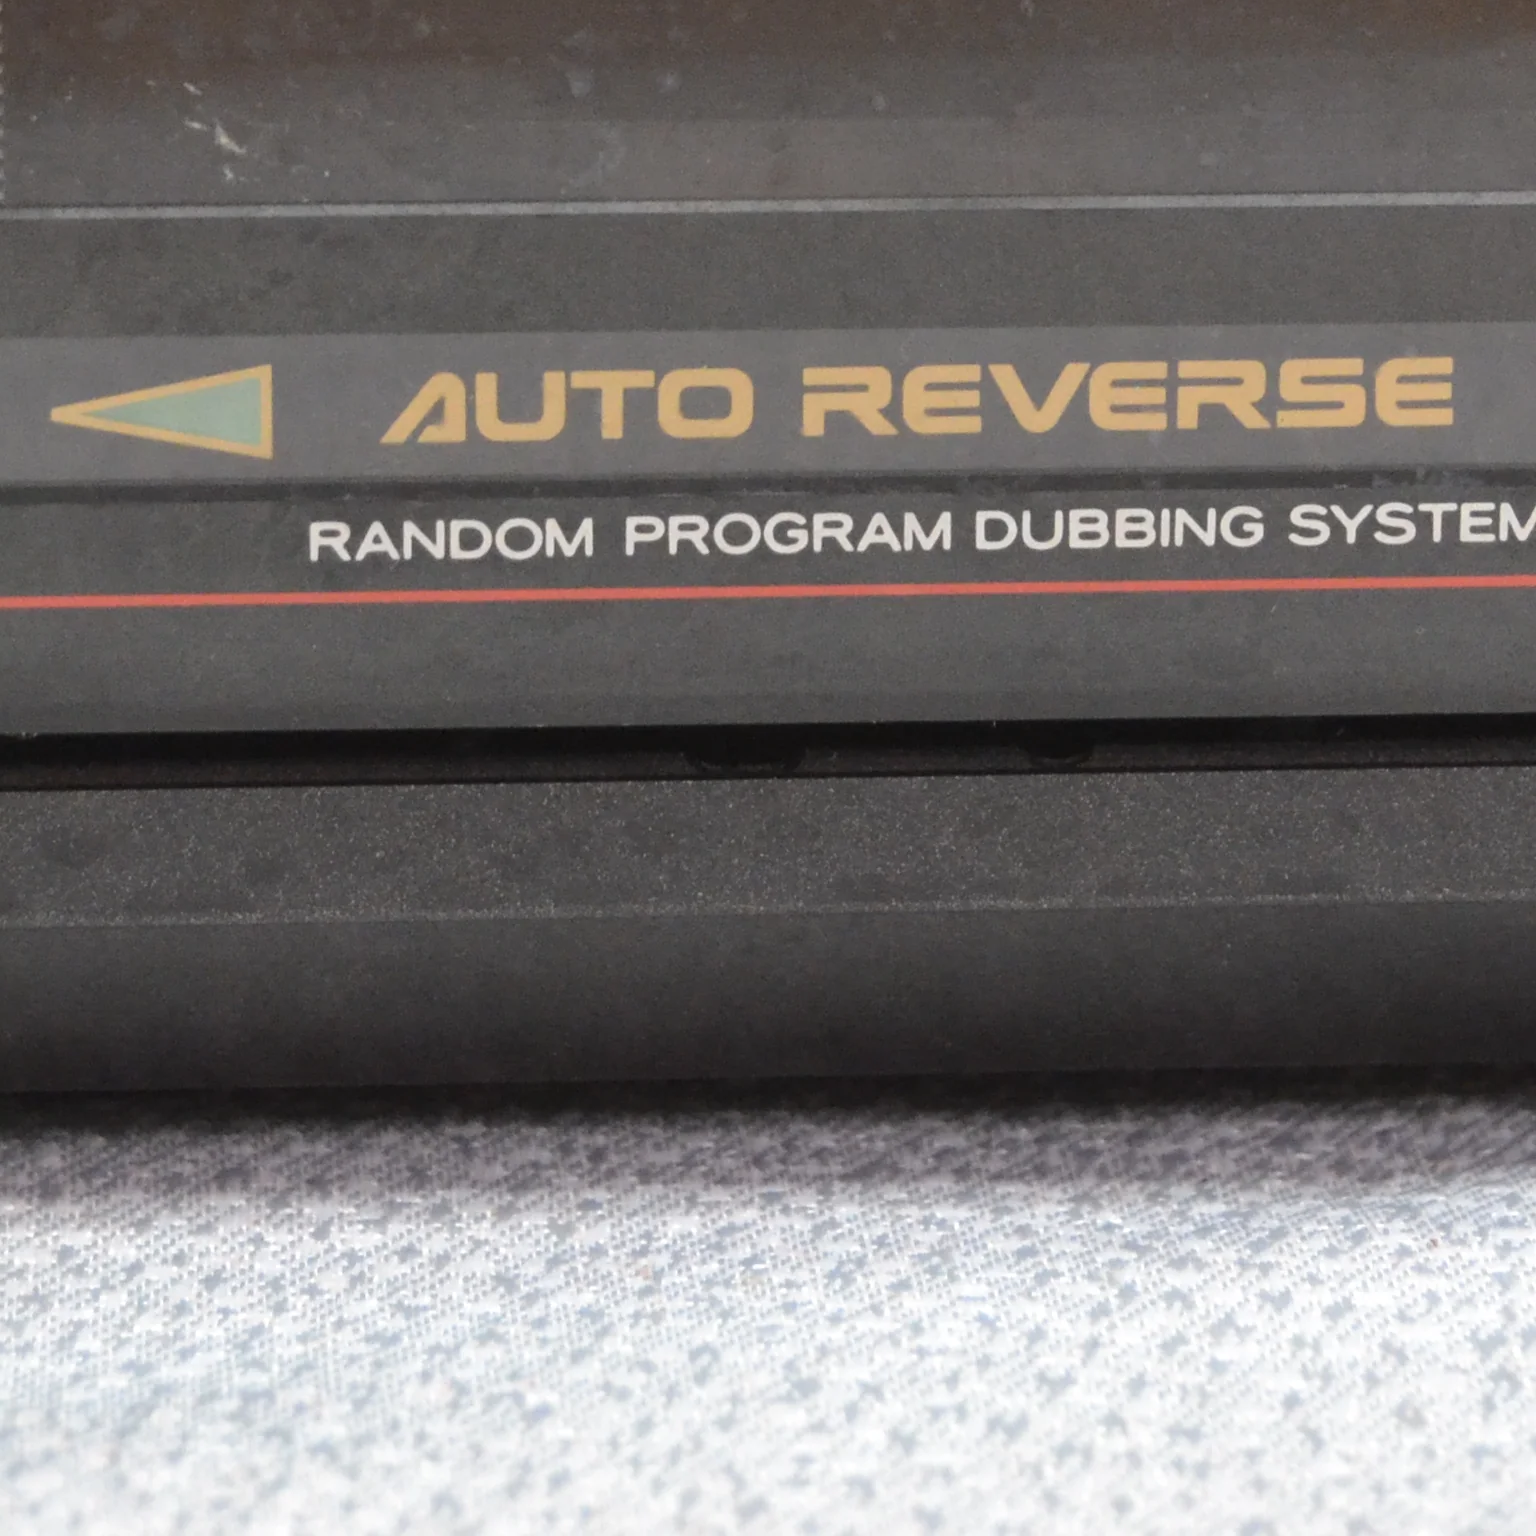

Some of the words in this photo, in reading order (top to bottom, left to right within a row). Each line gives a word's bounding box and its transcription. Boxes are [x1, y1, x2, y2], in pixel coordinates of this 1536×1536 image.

[379, 367, 754, 443] AUTO
[802, 356, 1454, 437] REVERSE
[309, 516, 594, 562] RANDOM
[624, 510, 951, 556] PROGRAM
[974, 505, 1265, 551] DUBBING
